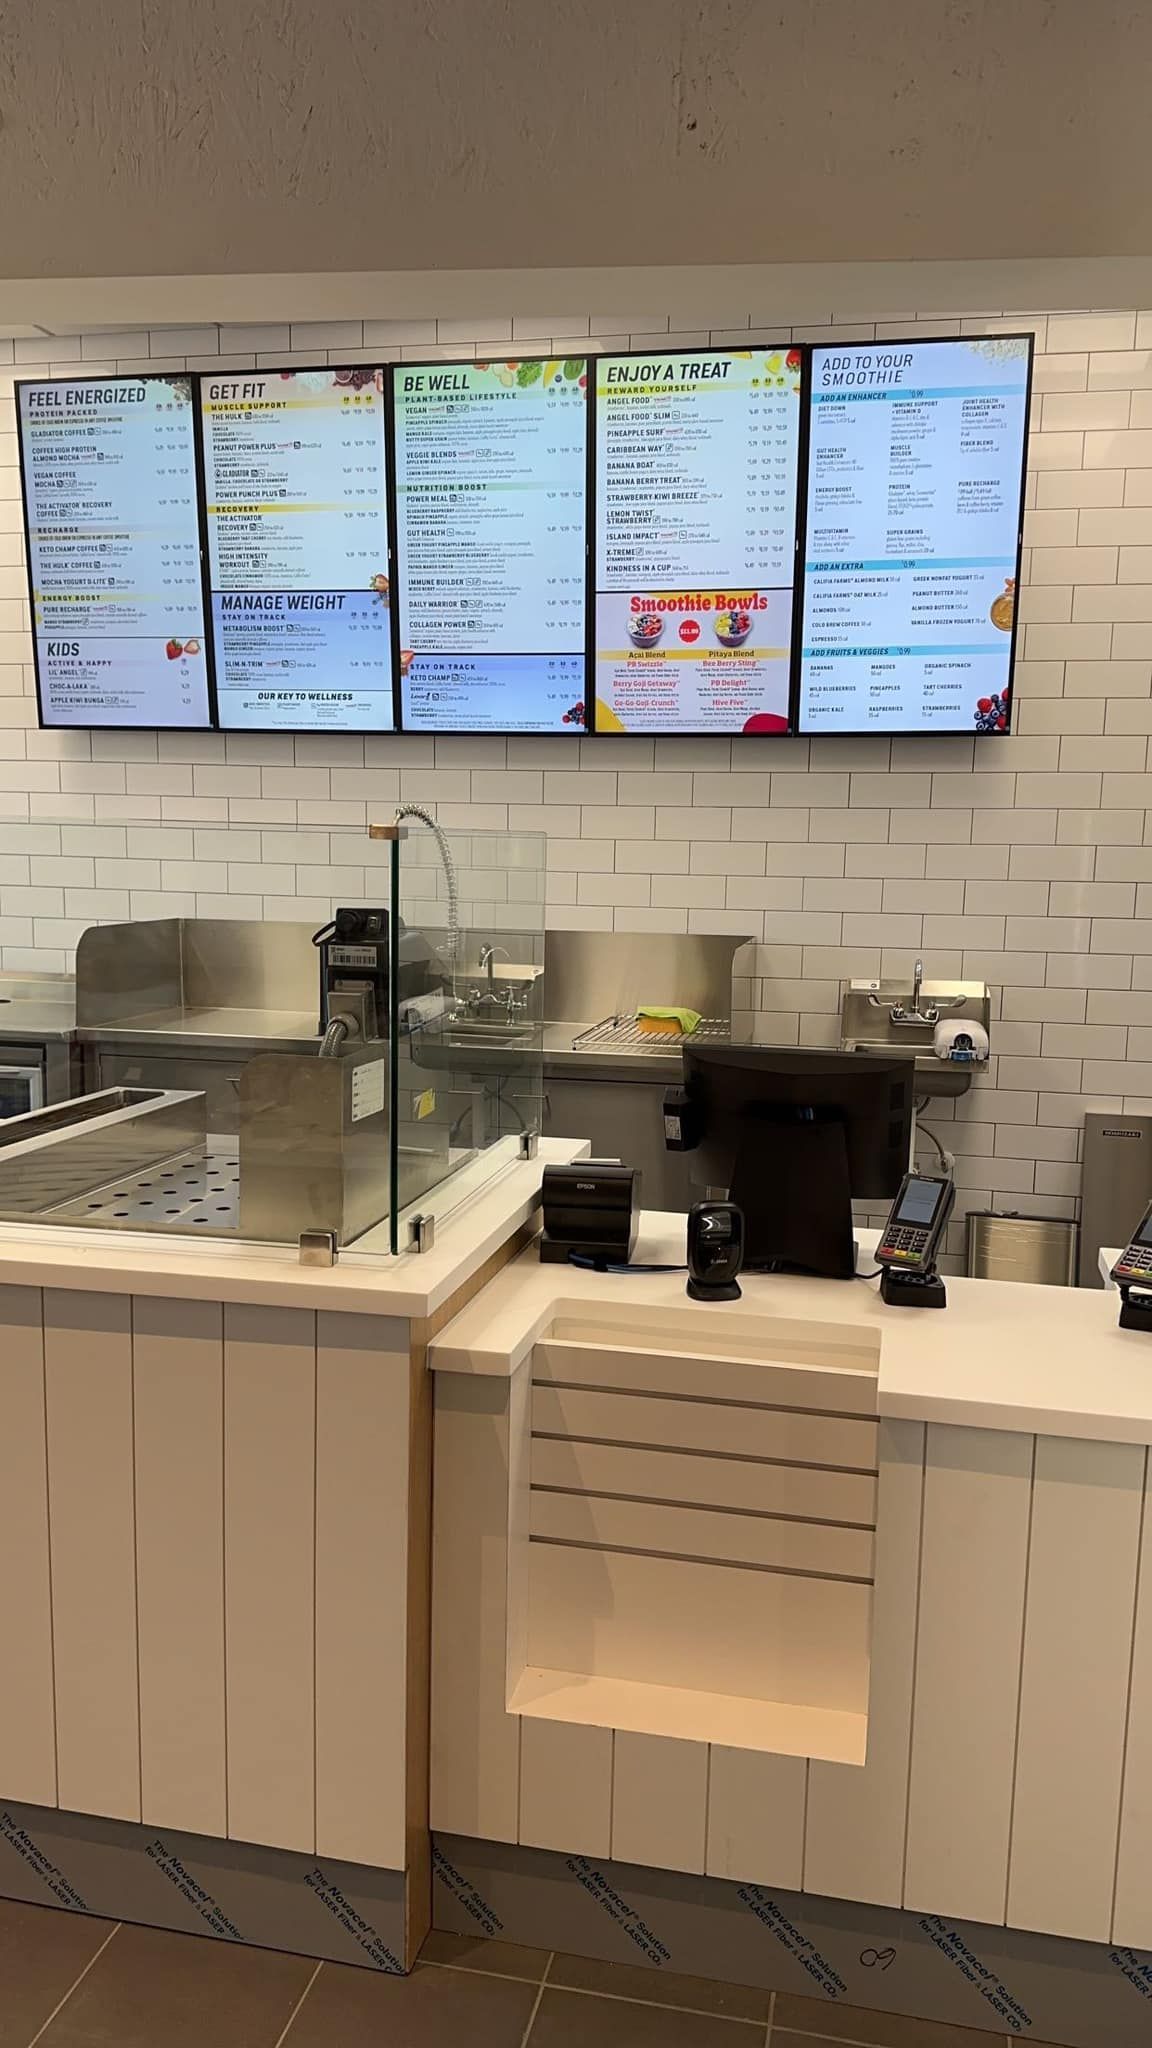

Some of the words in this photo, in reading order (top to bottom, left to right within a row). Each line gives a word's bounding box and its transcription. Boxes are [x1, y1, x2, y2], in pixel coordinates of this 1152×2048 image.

[822, 358, 850, 370] ADD
[856, 356, 872, 369] TO
[876, 354, 913, 368] YOUR
[607, 365, 662, 382] ENJOY
[664, 365, 676, 380] A
[680, 362, 731, 379] TREAT
[822, 370, 904, 386] SMOOTHIE
[210, 384, 239, 399] GET
[243, 383, 266, 398] FIT
[404, 376, 424, 392] BE
[428, 374, 470, 391] WELL
[607, 386, 645, 394] REWARD
[649, 384, 697, 393] YOURSELF
[29, 391, 62, 407] FEEL
[66, 388, 146, 405] ENERGIZED
[405, 394, 466, 403] PLANT-BASED
[469, 392, 517, 400] LIFESTYLE
[607, 446, 646, 454] CARIBBEAN
[407, 484, 454, 492] NUTRITION
[221, 596, 284, 610] MANAGE
[288, 595, 346, 610] WEIGHT
[631, 594, 711, 612] Smoothie
[715, 593, 768, 611] Bowls
[47, 642, 80, 656] KIDS
[2, 1812, 16, 1830] The
[59, 1879, 88, 1910] Solutio
[145, 1846, 157, 1858] for
[156, 1858, 179, 1884] LASER
[179, 1884, 196, 1904] Fiber
[201, 1909, 224, 1933] LASER
[154, 1840, 168, 1857] The
[213, 1907, 244, 1940] Solutio
[737, 1888, 751, 1901] for
[749, 1902, 774, 1928] LASER
[774, 1928, 793, 1949] Fiber
[798, 1955, 823, 1982] LASER
[748, 1884, 764, 1900] The
[812, 1952, 847, 1992] Solution
[919, 1920, 932, 1933] for
[931, 1933, 957, 1960] LASER
[956, 1960, 976, 1981] Fiber
[982, 1988, 1008, 2016] LASER
[930, 1915, 946, 1932] The
[996, 1986, 1032, 2026] Solution
